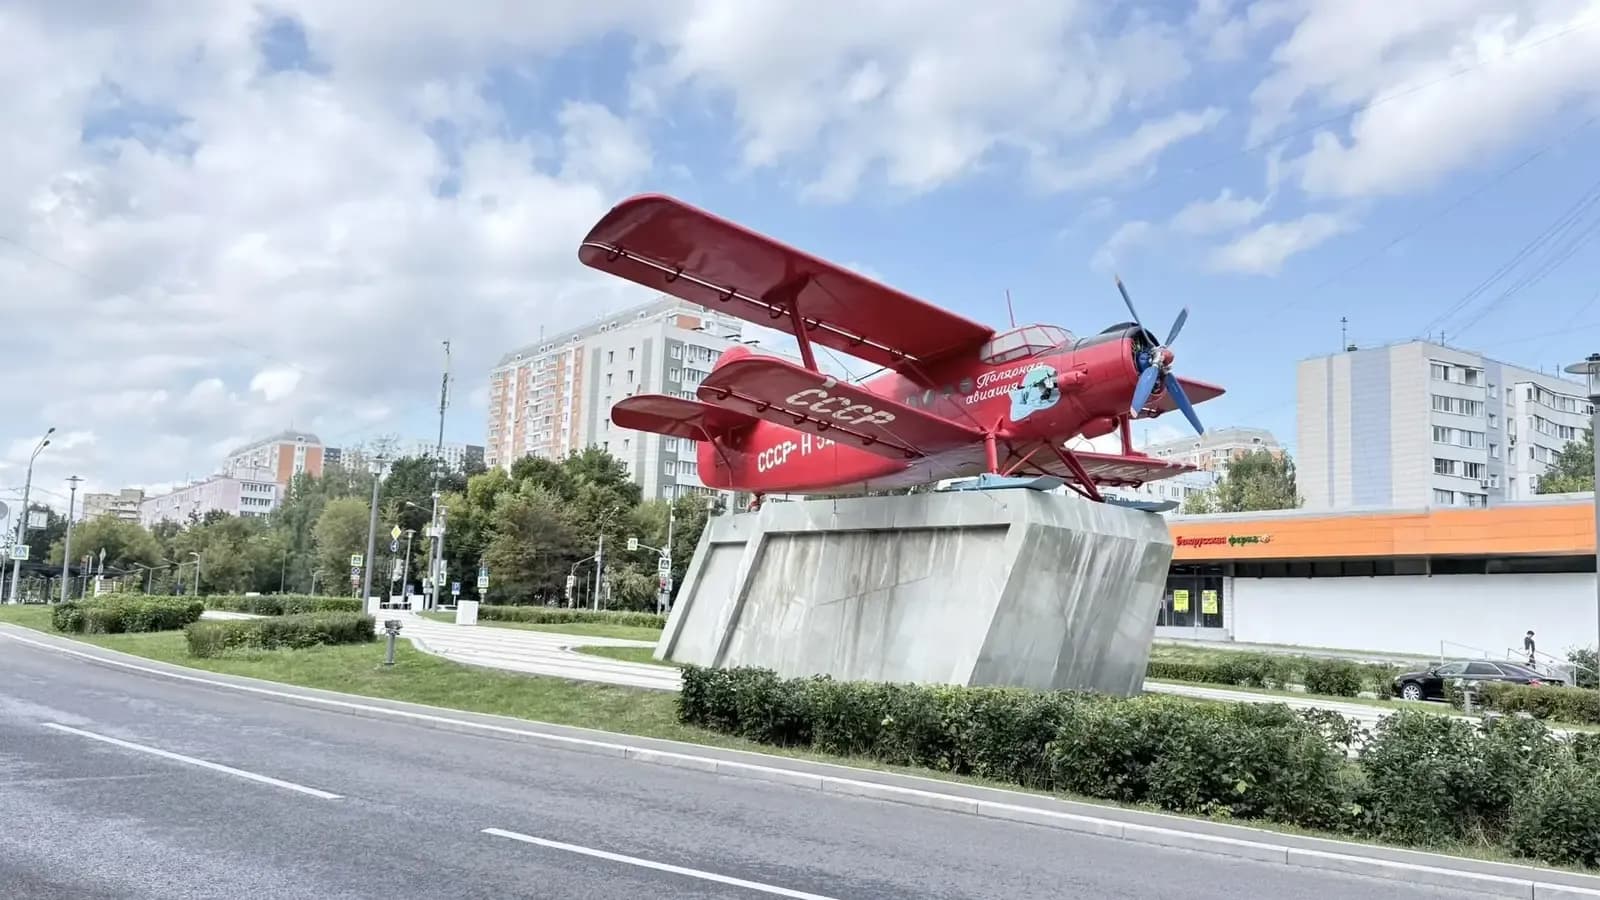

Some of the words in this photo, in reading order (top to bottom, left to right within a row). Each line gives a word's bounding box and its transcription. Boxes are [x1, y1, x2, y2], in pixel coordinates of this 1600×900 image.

[976, 361, 1044, 389] Полярная
[785, 388, 896, 425] СССР
[966, 382, 1019, 405] авиация
